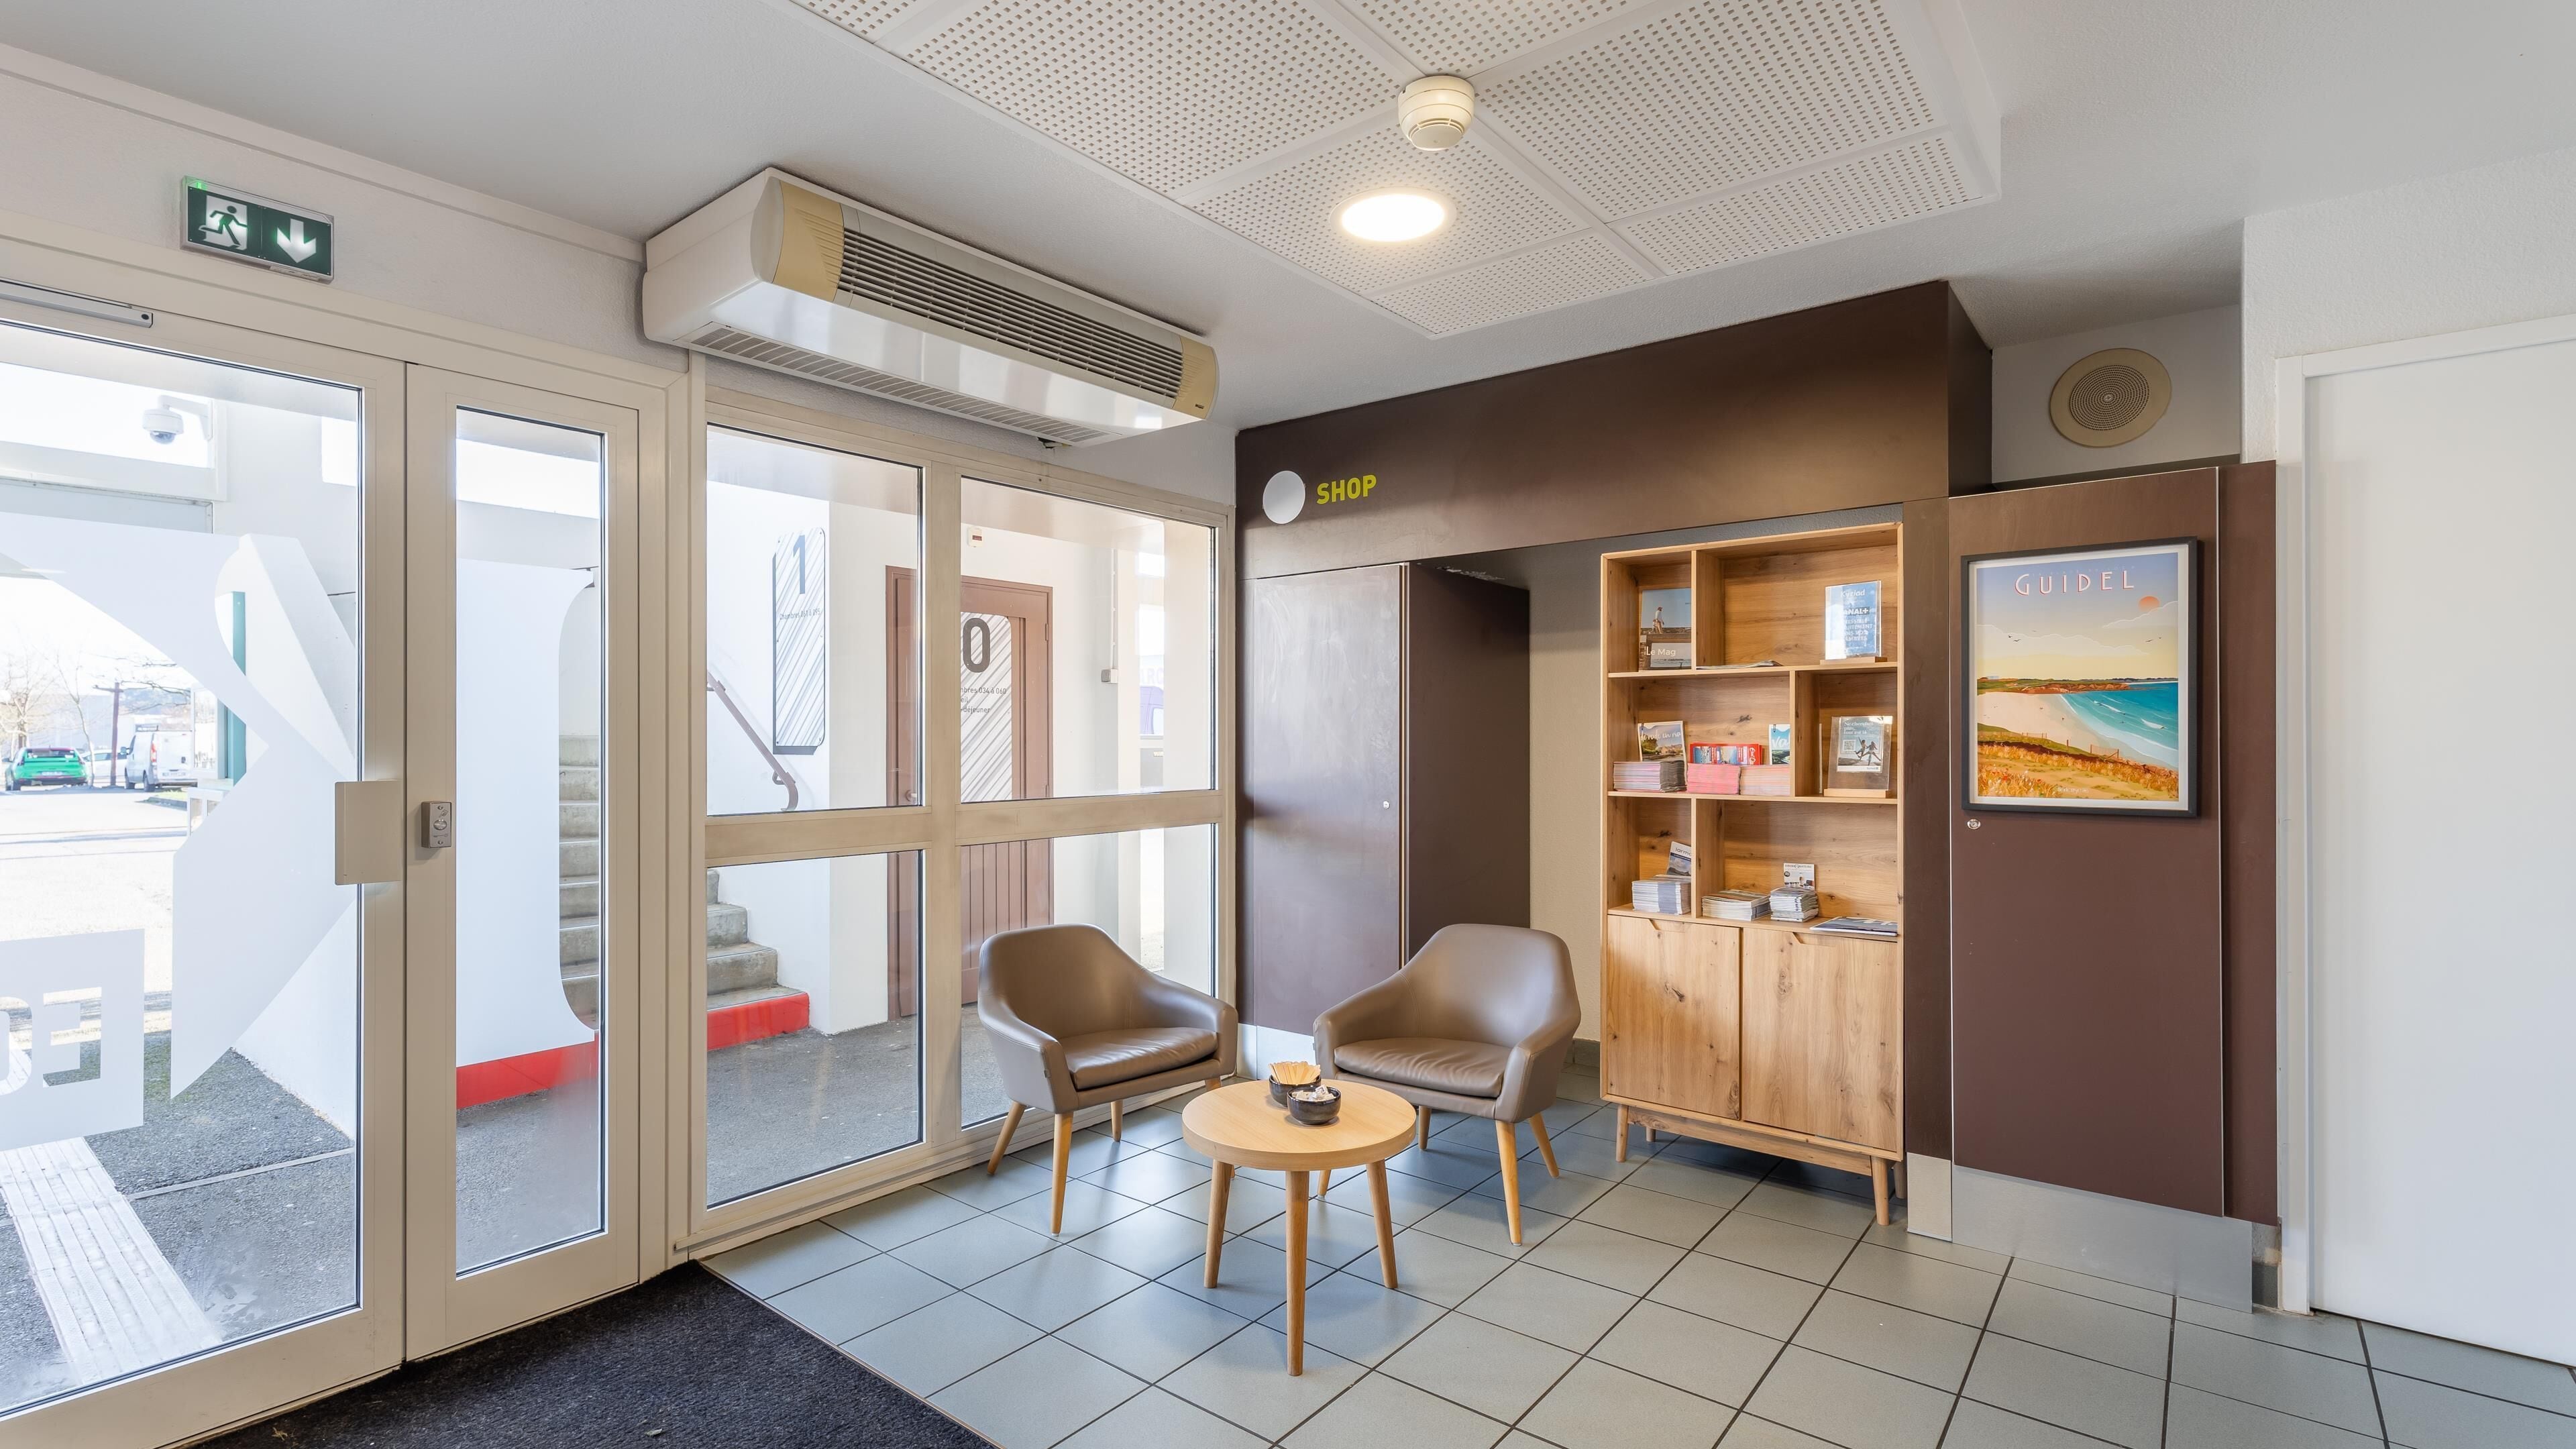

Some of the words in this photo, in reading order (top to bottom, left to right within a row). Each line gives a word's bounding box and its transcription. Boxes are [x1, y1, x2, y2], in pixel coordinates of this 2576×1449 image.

[1316, 474, 1377, 504] SHOP
[792, 534, 806, 594] 1
[1840, 589, 1866, 598] Kyriad
[2015, 570, 2135, 596] GUIDEL
[963, 617, 990, 674] 0
[1658, 649, 1676, 657] Mag
